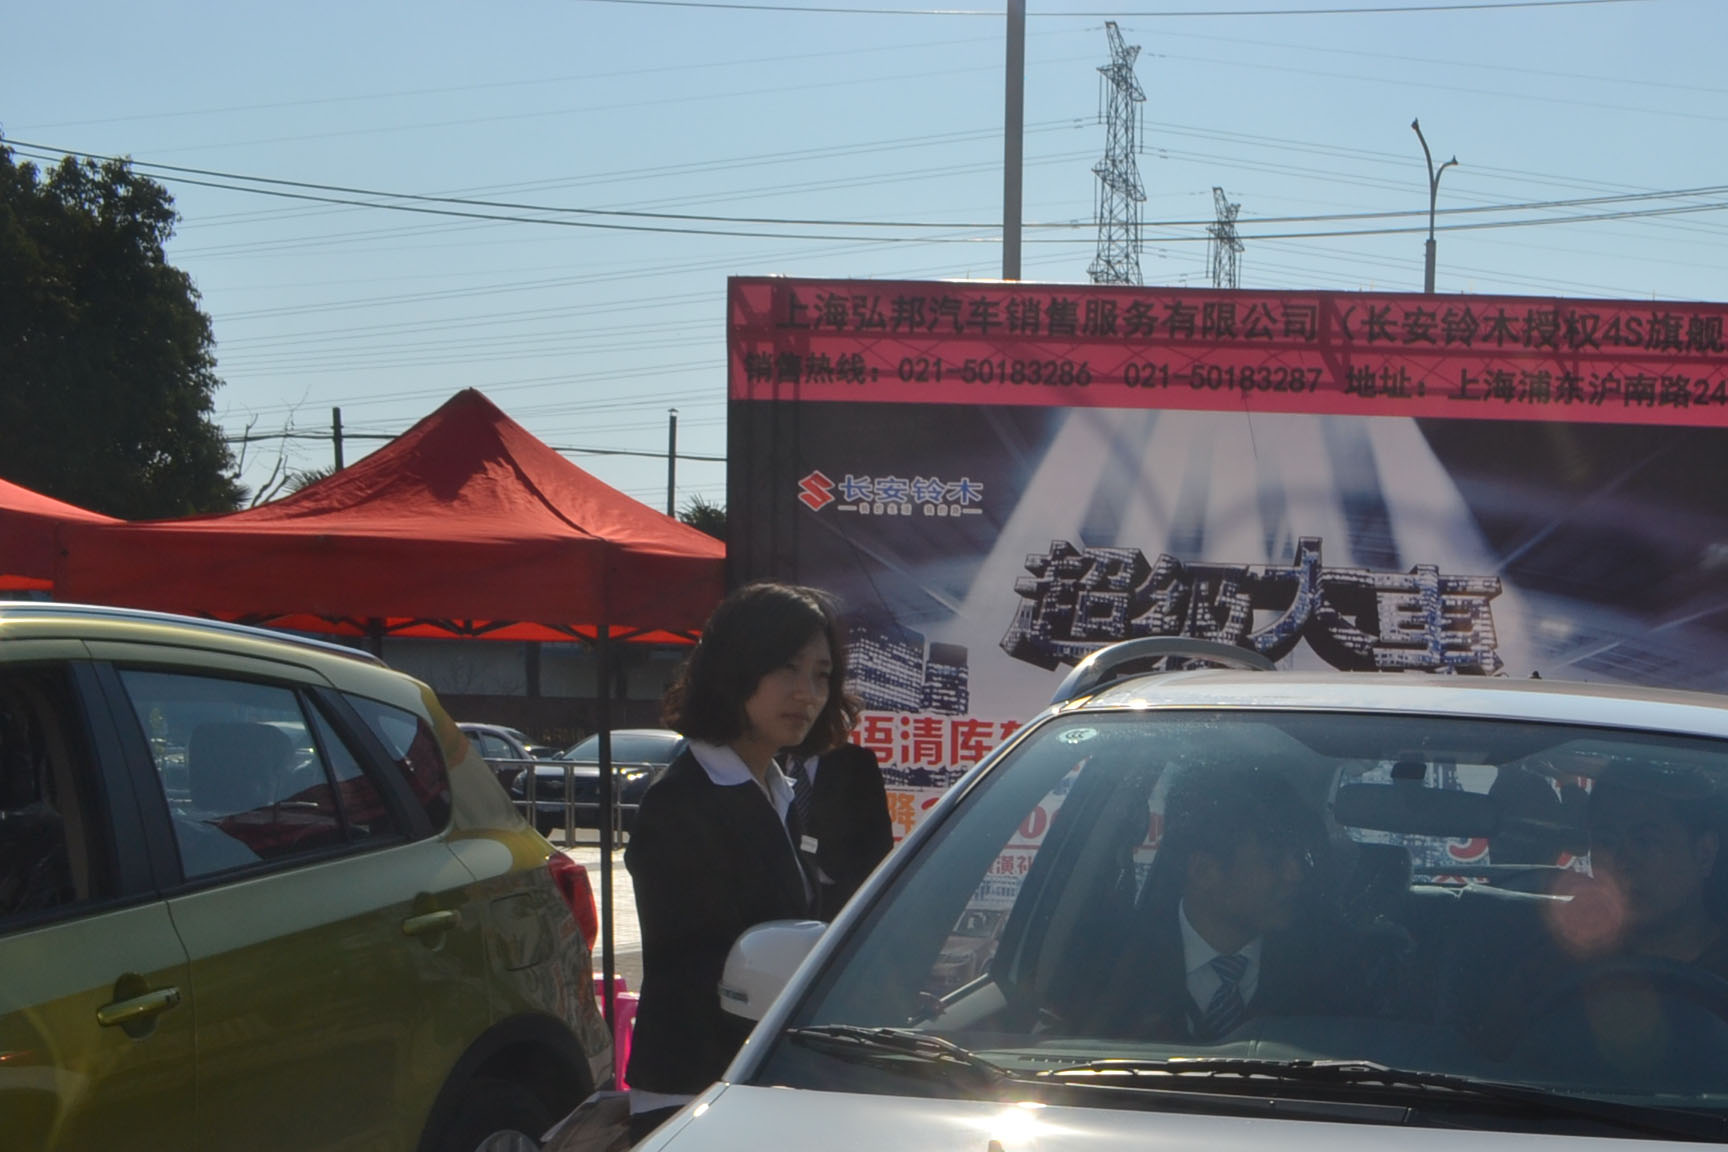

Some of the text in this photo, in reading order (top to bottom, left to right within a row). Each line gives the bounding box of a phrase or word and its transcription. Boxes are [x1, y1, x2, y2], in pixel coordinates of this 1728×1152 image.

[1123, 363, 1322, 394] 021-50183287
[838, 474, 984, 505] 长安铃木
